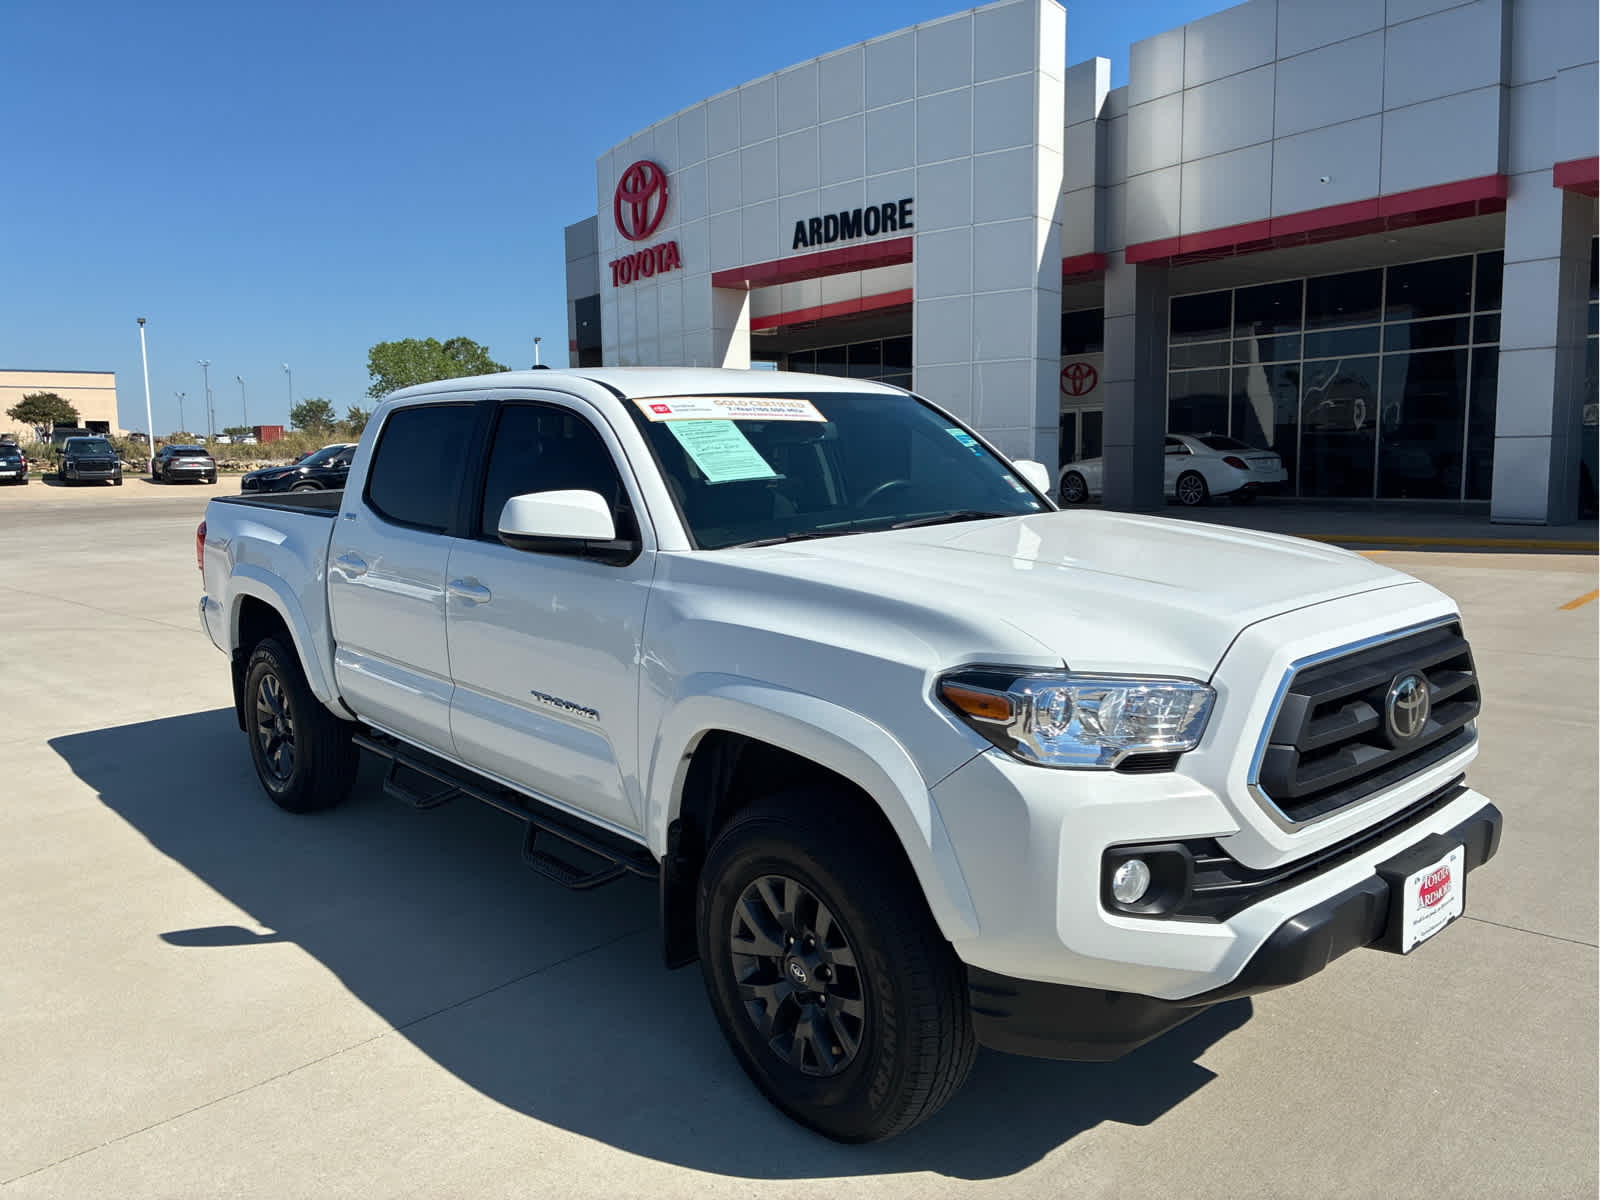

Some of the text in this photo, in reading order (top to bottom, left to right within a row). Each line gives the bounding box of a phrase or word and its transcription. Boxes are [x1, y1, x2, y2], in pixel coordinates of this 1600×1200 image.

[792, 198, 914, 250] ARDMORE
[609, 241, 682, 287] TOYOTA
[531, 689, 600, 721] TACOMA
